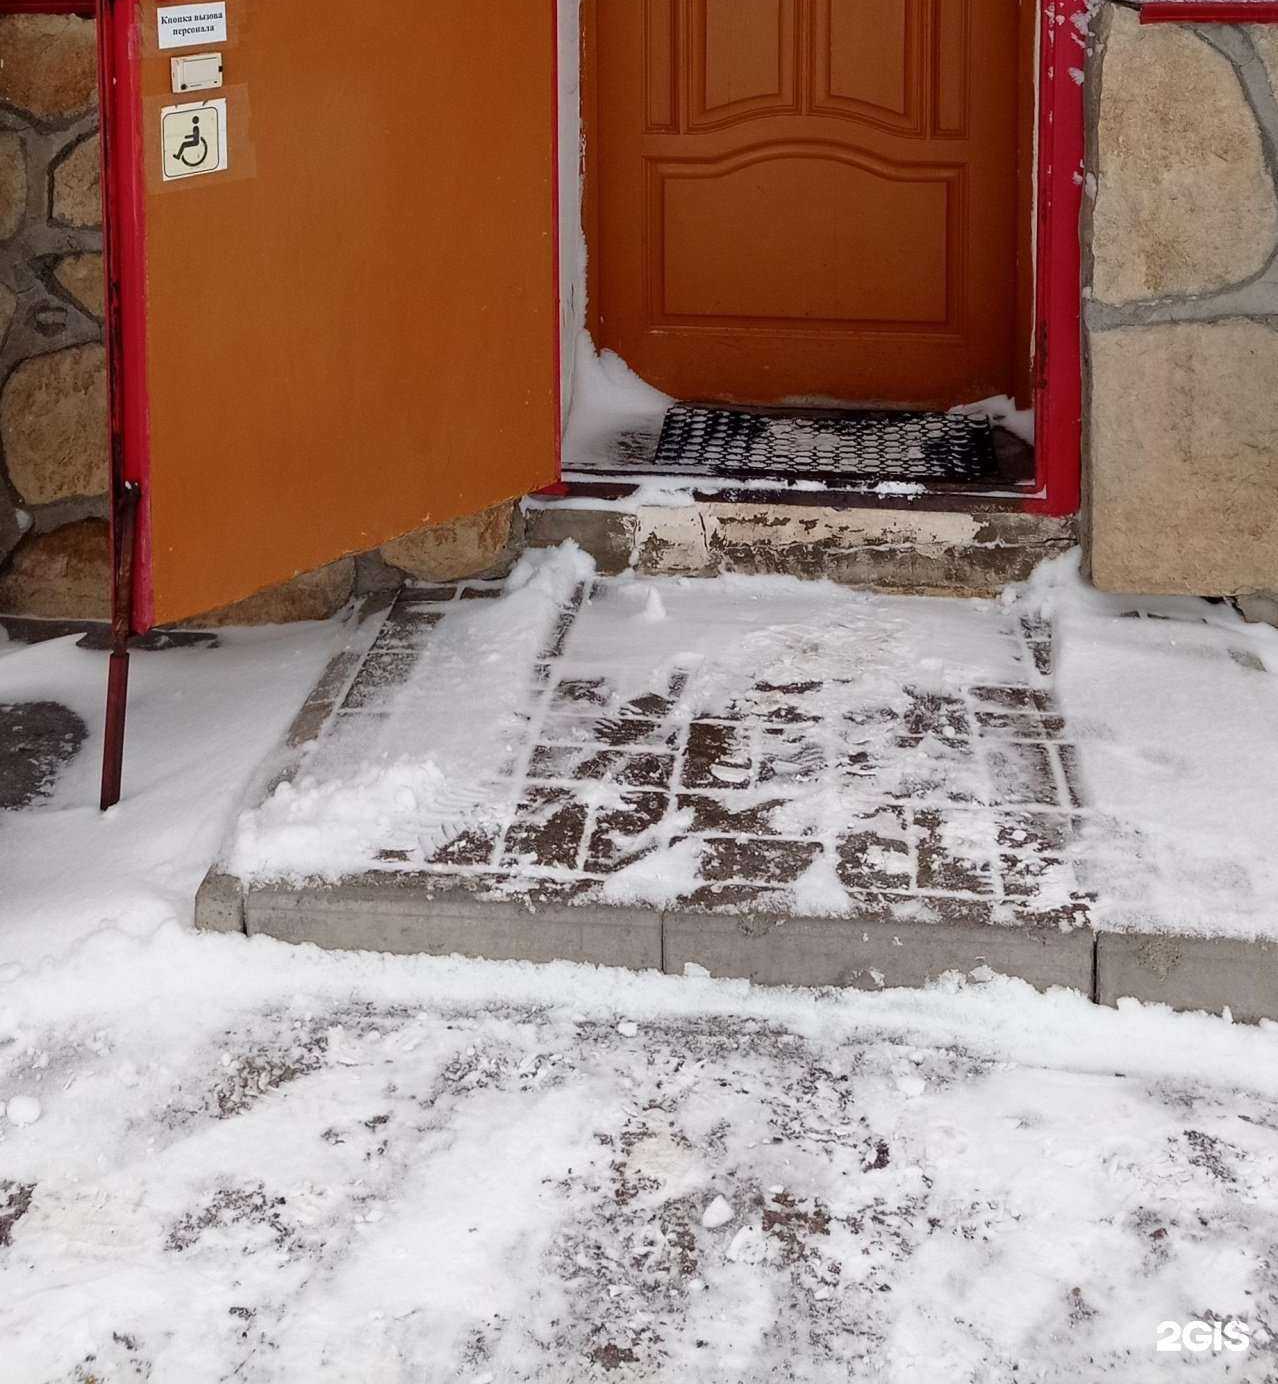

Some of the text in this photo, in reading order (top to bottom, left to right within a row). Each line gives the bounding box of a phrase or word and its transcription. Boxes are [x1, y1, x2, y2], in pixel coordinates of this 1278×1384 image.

[161, 12, 223, 25] Кнопка вызова
[172, 25, 215, 36] персонала
